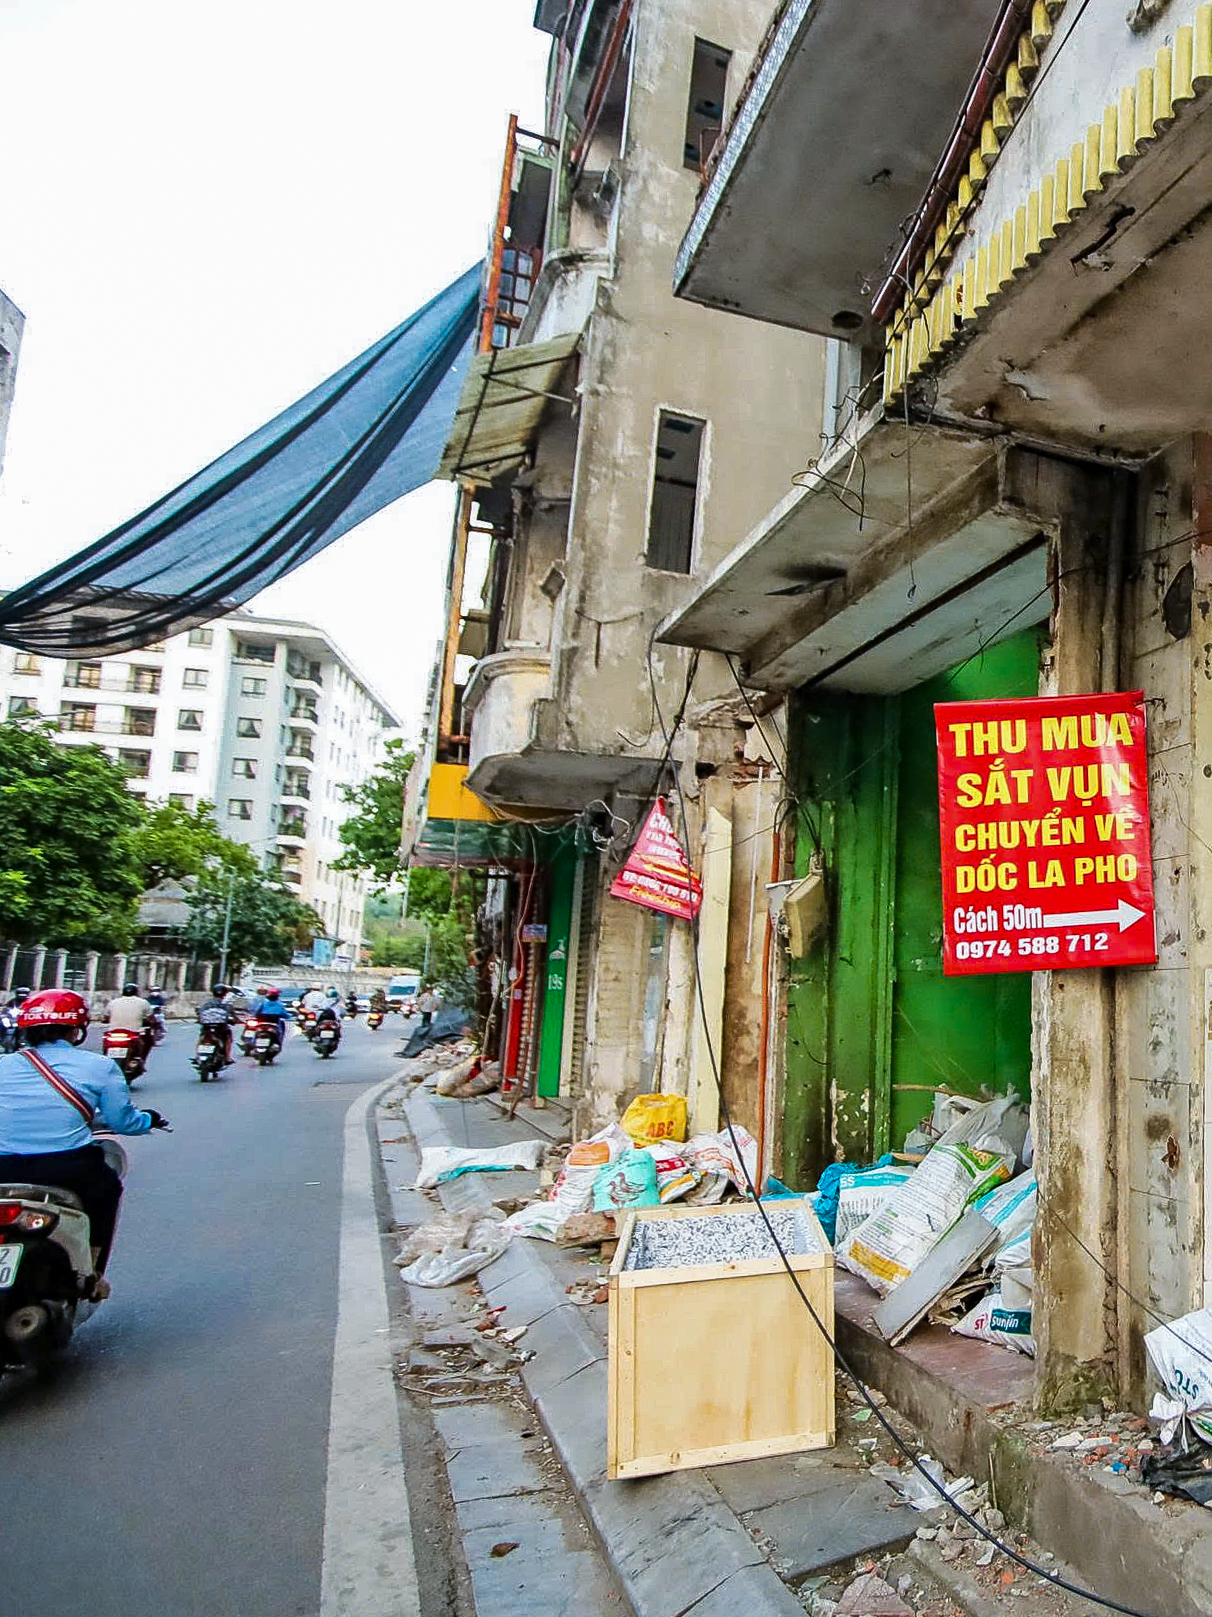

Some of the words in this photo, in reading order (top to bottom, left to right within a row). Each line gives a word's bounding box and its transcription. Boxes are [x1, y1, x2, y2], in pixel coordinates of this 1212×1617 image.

[949, 719, 1026, 757] THU
[1042, 712, 1134, 751] MUA
[956, 757, 1034, 808] SẮT
[1046, 763, 1130, 807] VỤN
[955, 807, 1085, 852] CHUYỂN
[956, 853, 1018, 894] DỐC
[1027, 859, 1066, 889] LA
[1074, 853, 1138, 886] PHO
[953, 906, 998, 934] Cách
[1003, 904, 1042, 931] 50m
[955, 939, 1012, 960] 0974
[1018, 936, 1060, 956] 588
[1066, 932, 1109, 953] 712
